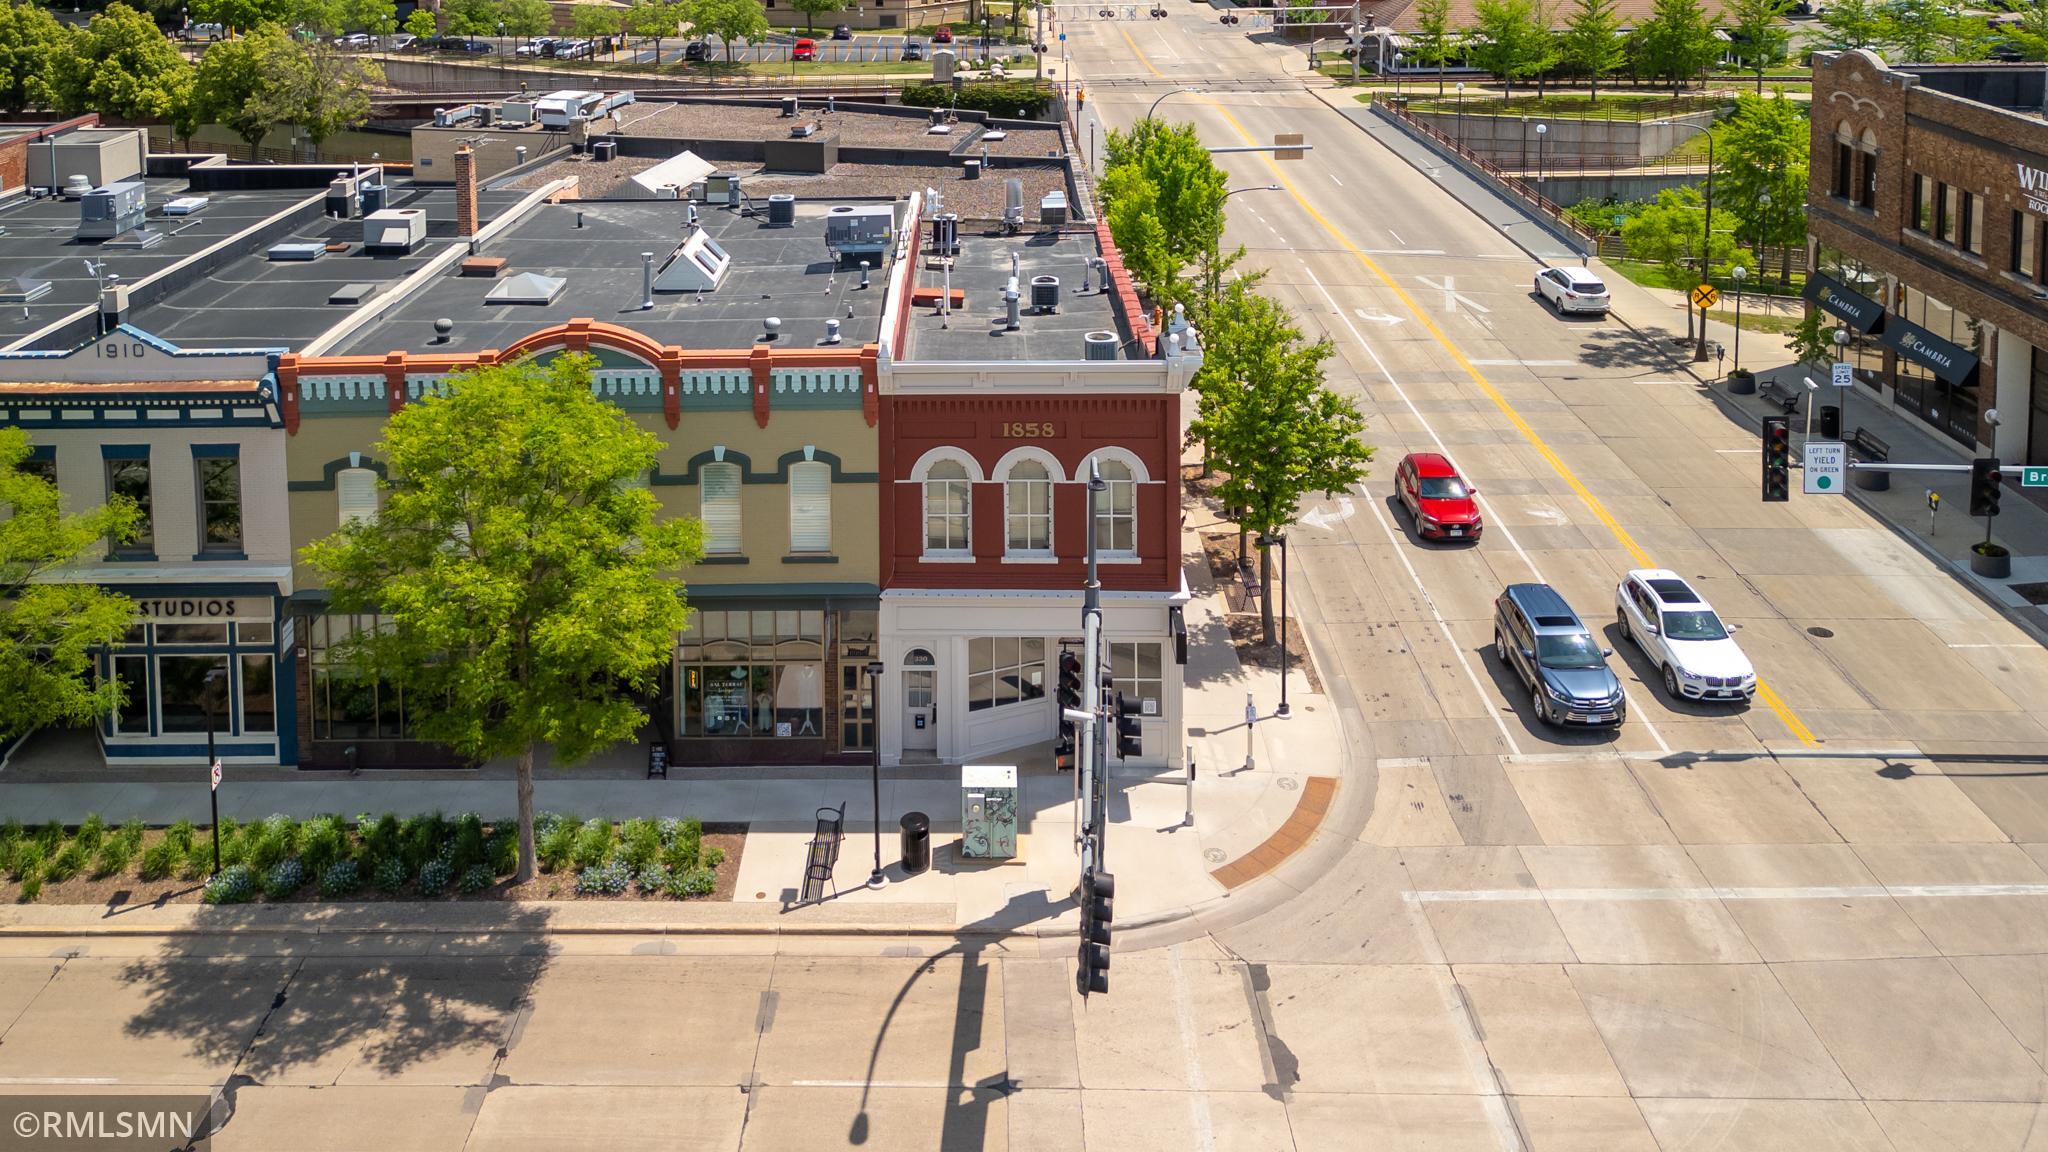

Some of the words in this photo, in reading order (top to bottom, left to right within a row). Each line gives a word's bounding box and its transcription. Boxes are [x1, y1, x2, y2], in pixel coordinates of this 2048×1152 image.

[2016, 163, 2048, 190] WI
[2029, 199, 2048, 214] ROC
[1828, 294, 1862, 318] CAMBRIA
[96, 343, 145, 358] 1910
[1913, 341, 1953, 368] CAMBRIA
[1834, 374, 1851, 383] 25
[1002, 422, 1056, 438] 1858
[1814, 456, 1836, 464] YIELD
[2030, 471, 2048, 482] Br
[140, 600, 236, 616] STUDIOS
